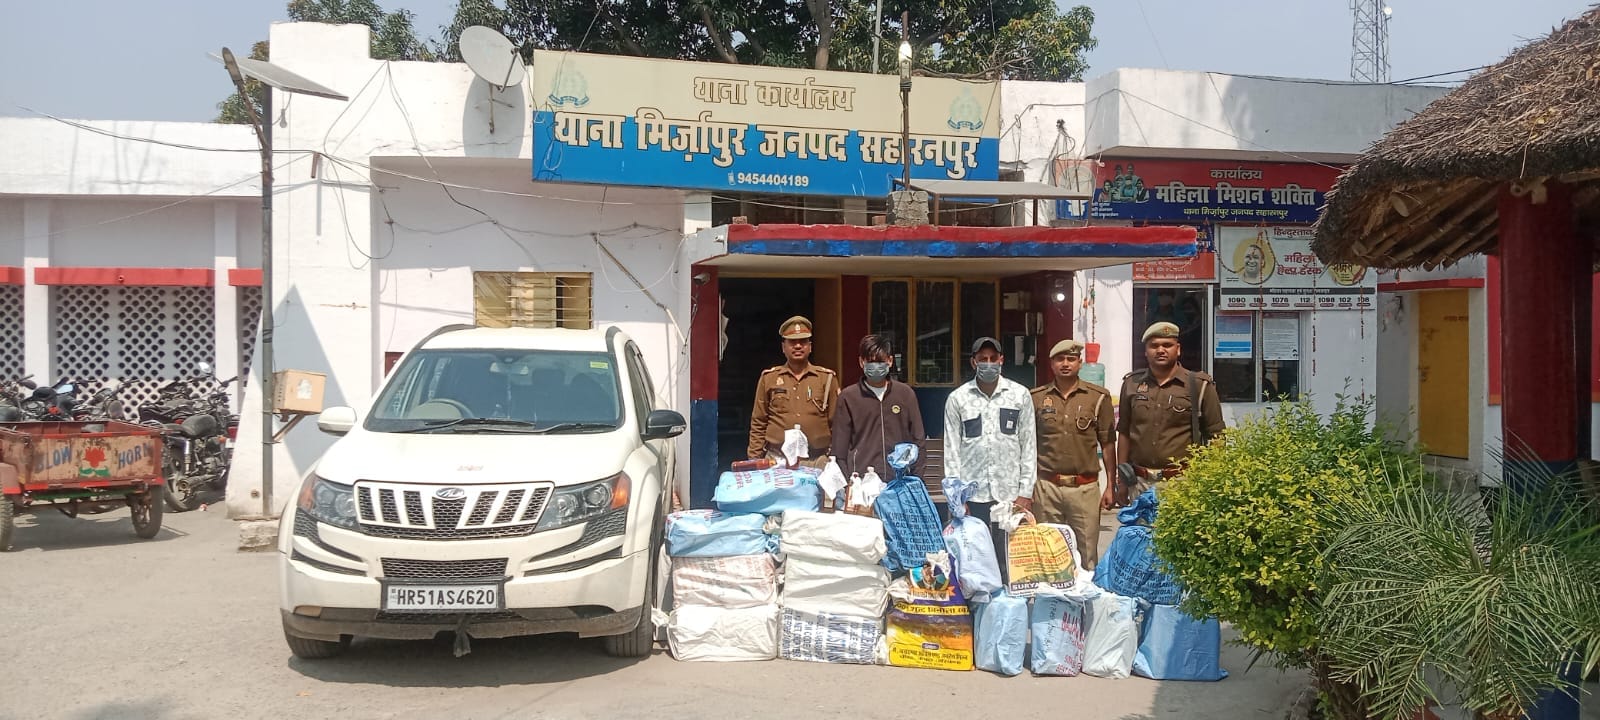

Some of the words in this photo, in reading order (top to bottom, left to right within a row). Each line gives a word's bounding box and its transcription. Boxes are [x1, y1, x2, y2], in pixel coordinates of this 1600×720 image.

[693, 76, 750, 106] थाना
[754, 77, 857, 112] कार्यालय
[554, 111, 629, 149] थाना
[634, 106, 749, 168] मिर्ज़ापुर
[755, 124, 851, 162] जनपद
[737, 172, 810, 189] 9454404189
[1210, 165, 1263, 180] कार्यालय
[1155, 181, 1211, 204] महिला
[1216, 182, 1266, 205] मिशन
[1270, 183, 1318, 206] शक्ति
[33, 445, 73, 474] BLOW
[117, 442, 152, 470] HORN
[396, 589, 495, 607] HR51AS4620
